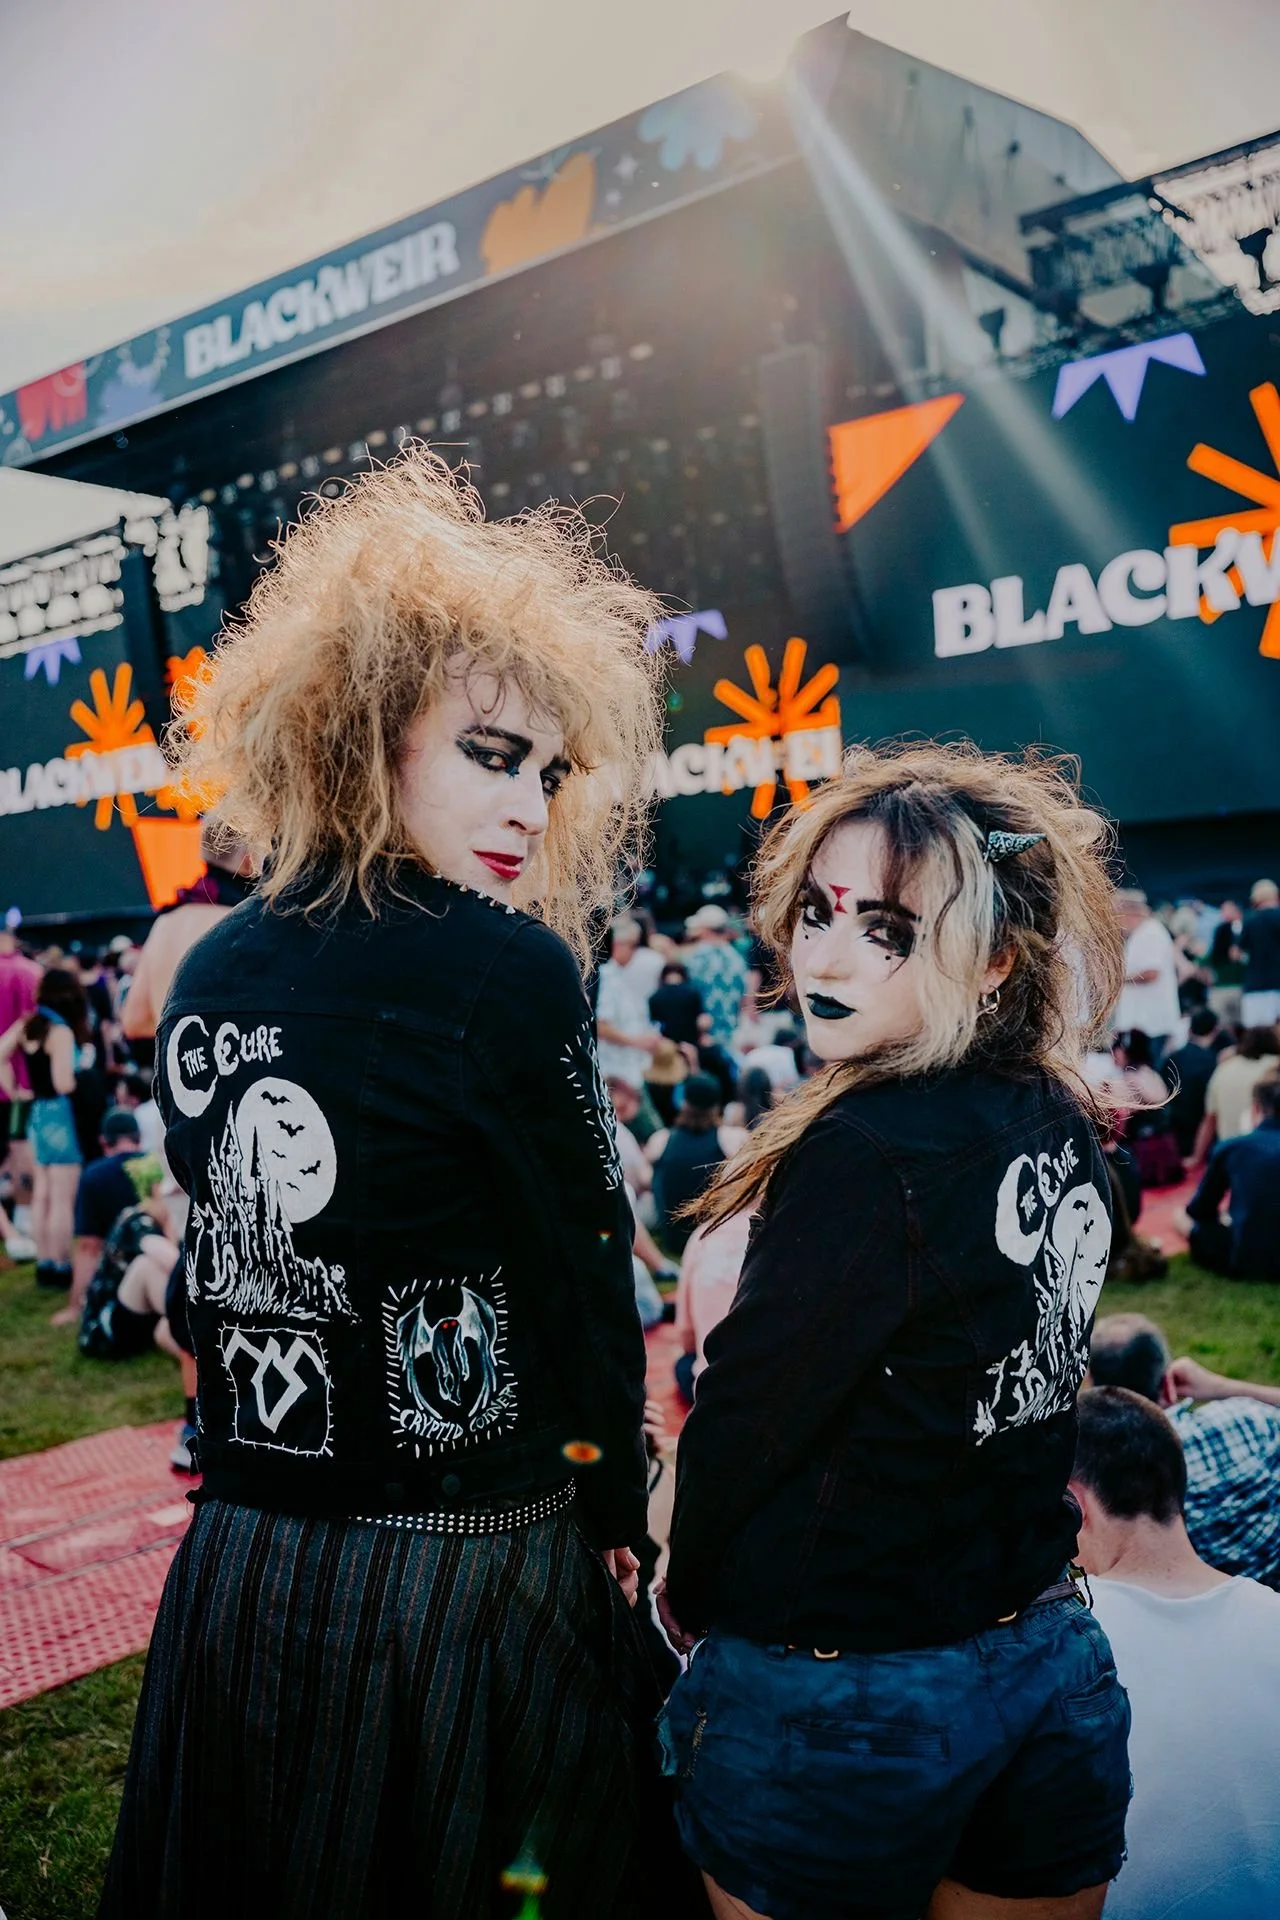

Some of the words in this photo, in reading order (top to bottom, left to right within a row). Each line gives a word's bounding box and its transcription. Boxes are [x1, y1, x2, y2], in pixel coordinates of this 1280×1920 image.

[183, 222, 460, 379] BLACKWEIR
[181, 1047, 208, 1078] THE
[213, 1022, 283, 1076] CURE
[399, 1408, 464, 1442] CRYPTID
[469, 1382, 517, 1432] CORNER
